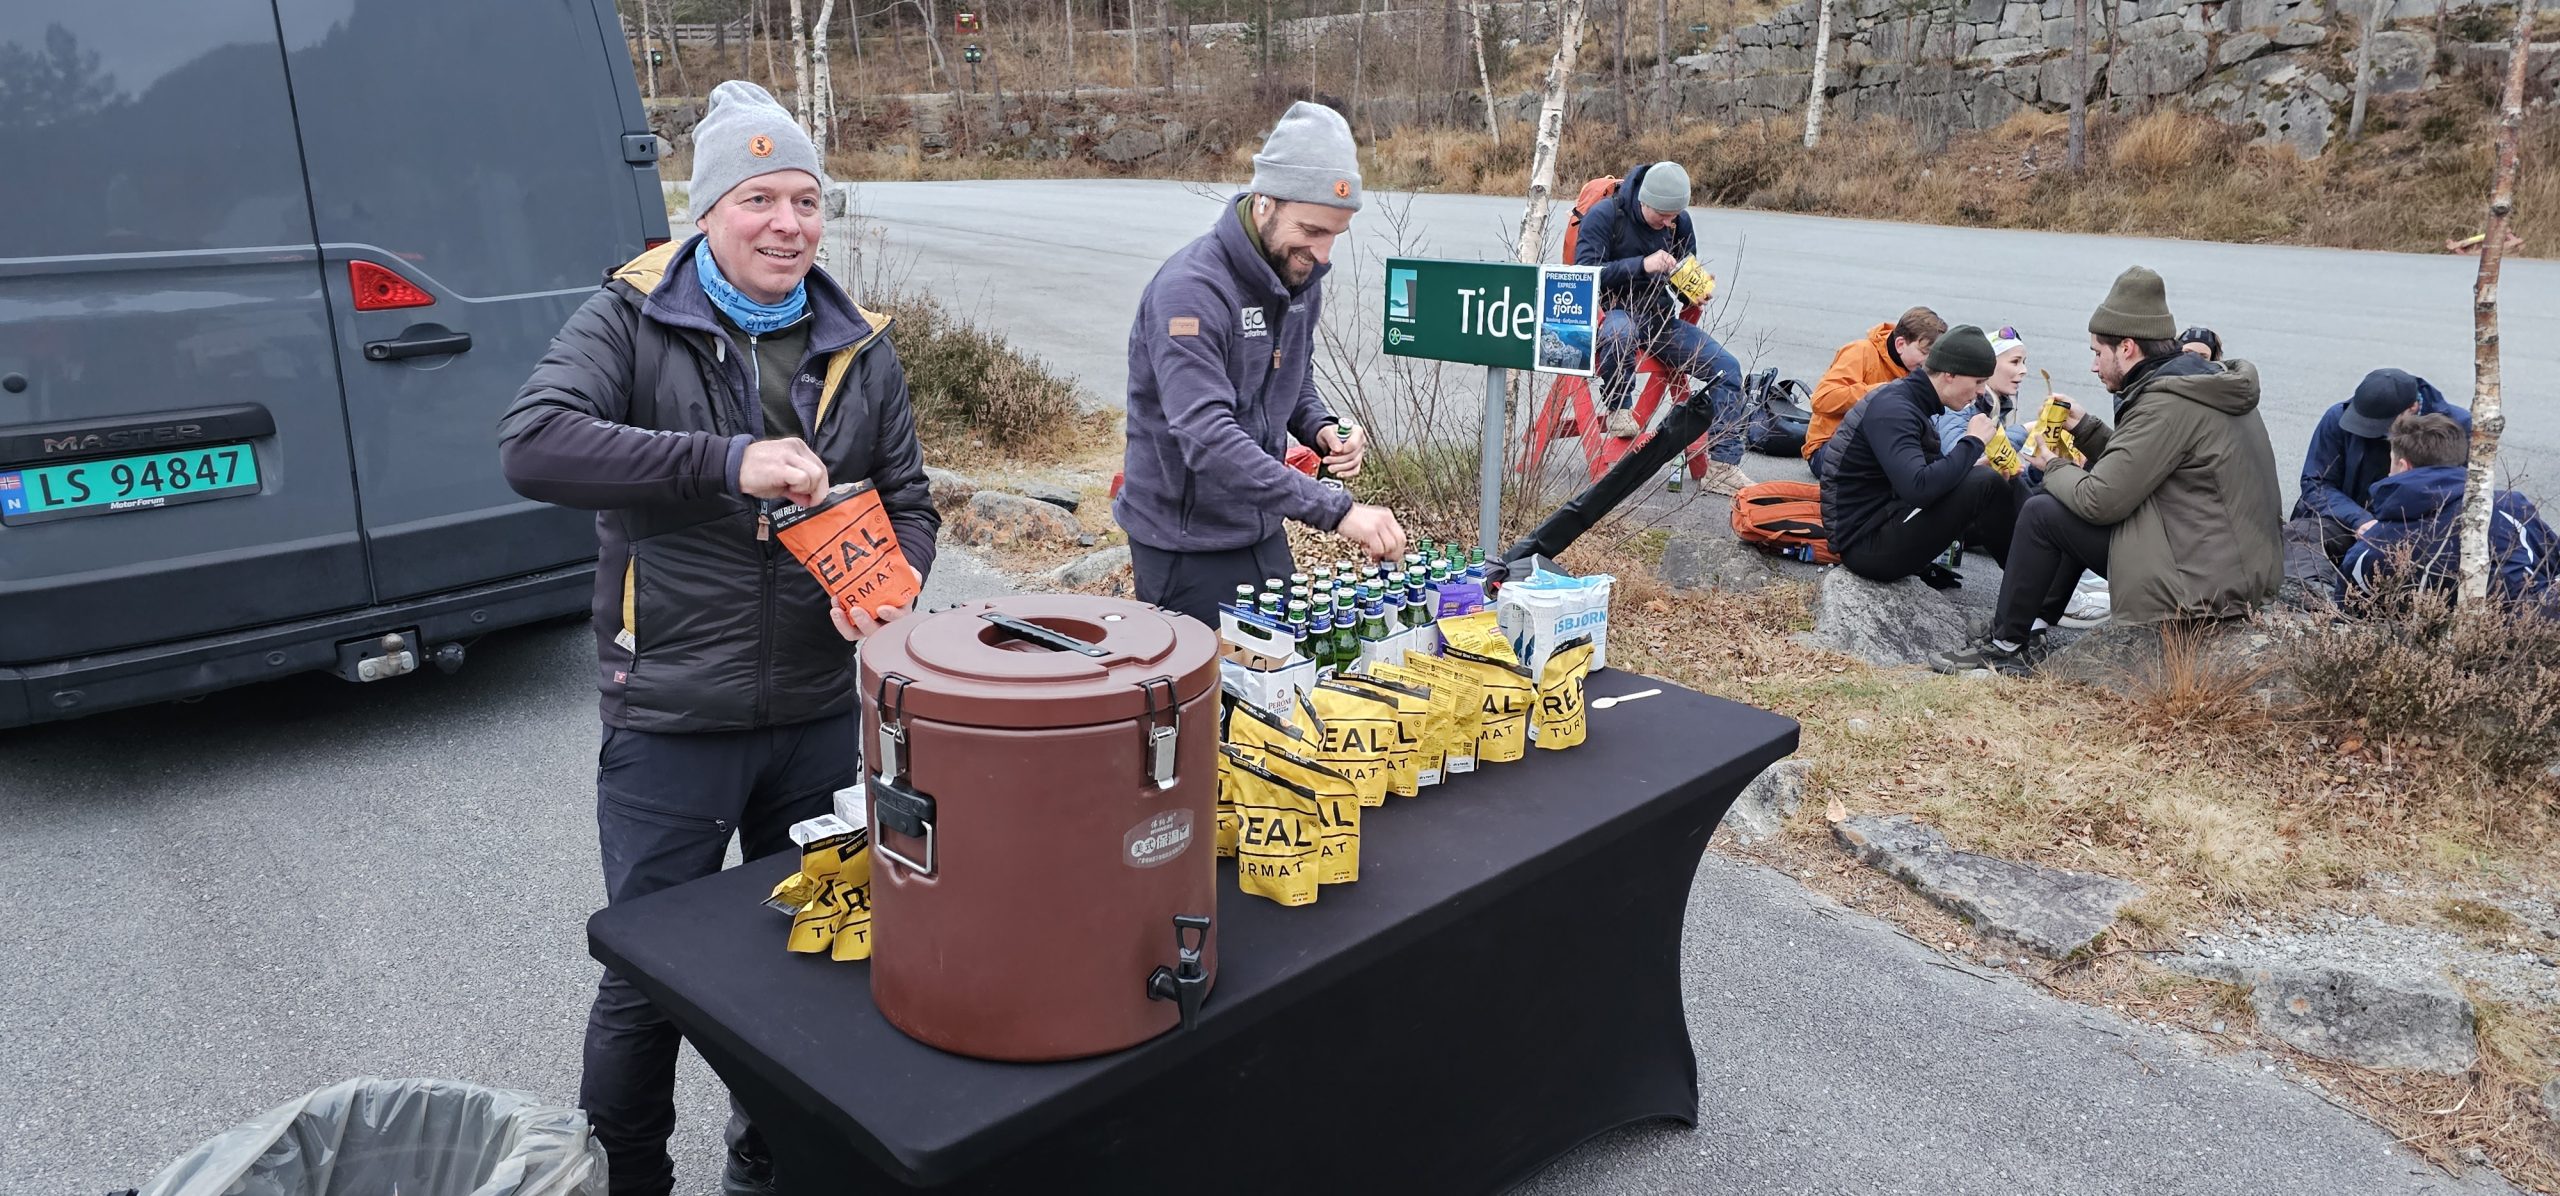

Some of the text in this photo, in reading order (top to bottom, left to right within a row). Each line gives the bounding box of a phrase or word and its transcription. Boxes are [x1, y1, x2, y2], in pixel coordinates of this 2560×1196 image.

[1546, 272, 1592, 282] PREIKESTOLEN
[1553, 291, 1574, 305] GO
[1457, 286, 1534, 340] Tide
[1552, 303, 1583, 318] fjords
[744, 320, 780, 330] FAIR
[44, 424, 202, 453] MASTER
[2043, 425, 2061, 439] RE
[1993, 445, 2011, 467] RE
[39, 451, 239, 507] LS 94847
[8, 498, 21, 510] N
[817, 528, 889, 586] EAL
[1554, 610, 1607, 636] ISBJØRN
[1268, 697, 1292, 710] PERONI
[1482, 694, 1522, 715] AL
[1542, 675, 1584, 716] REA
[1320, 727, 1389, 753] EAL
[1480, 724, 1513, 741] MAT
[1338, 767, 1379, 780] MAT
